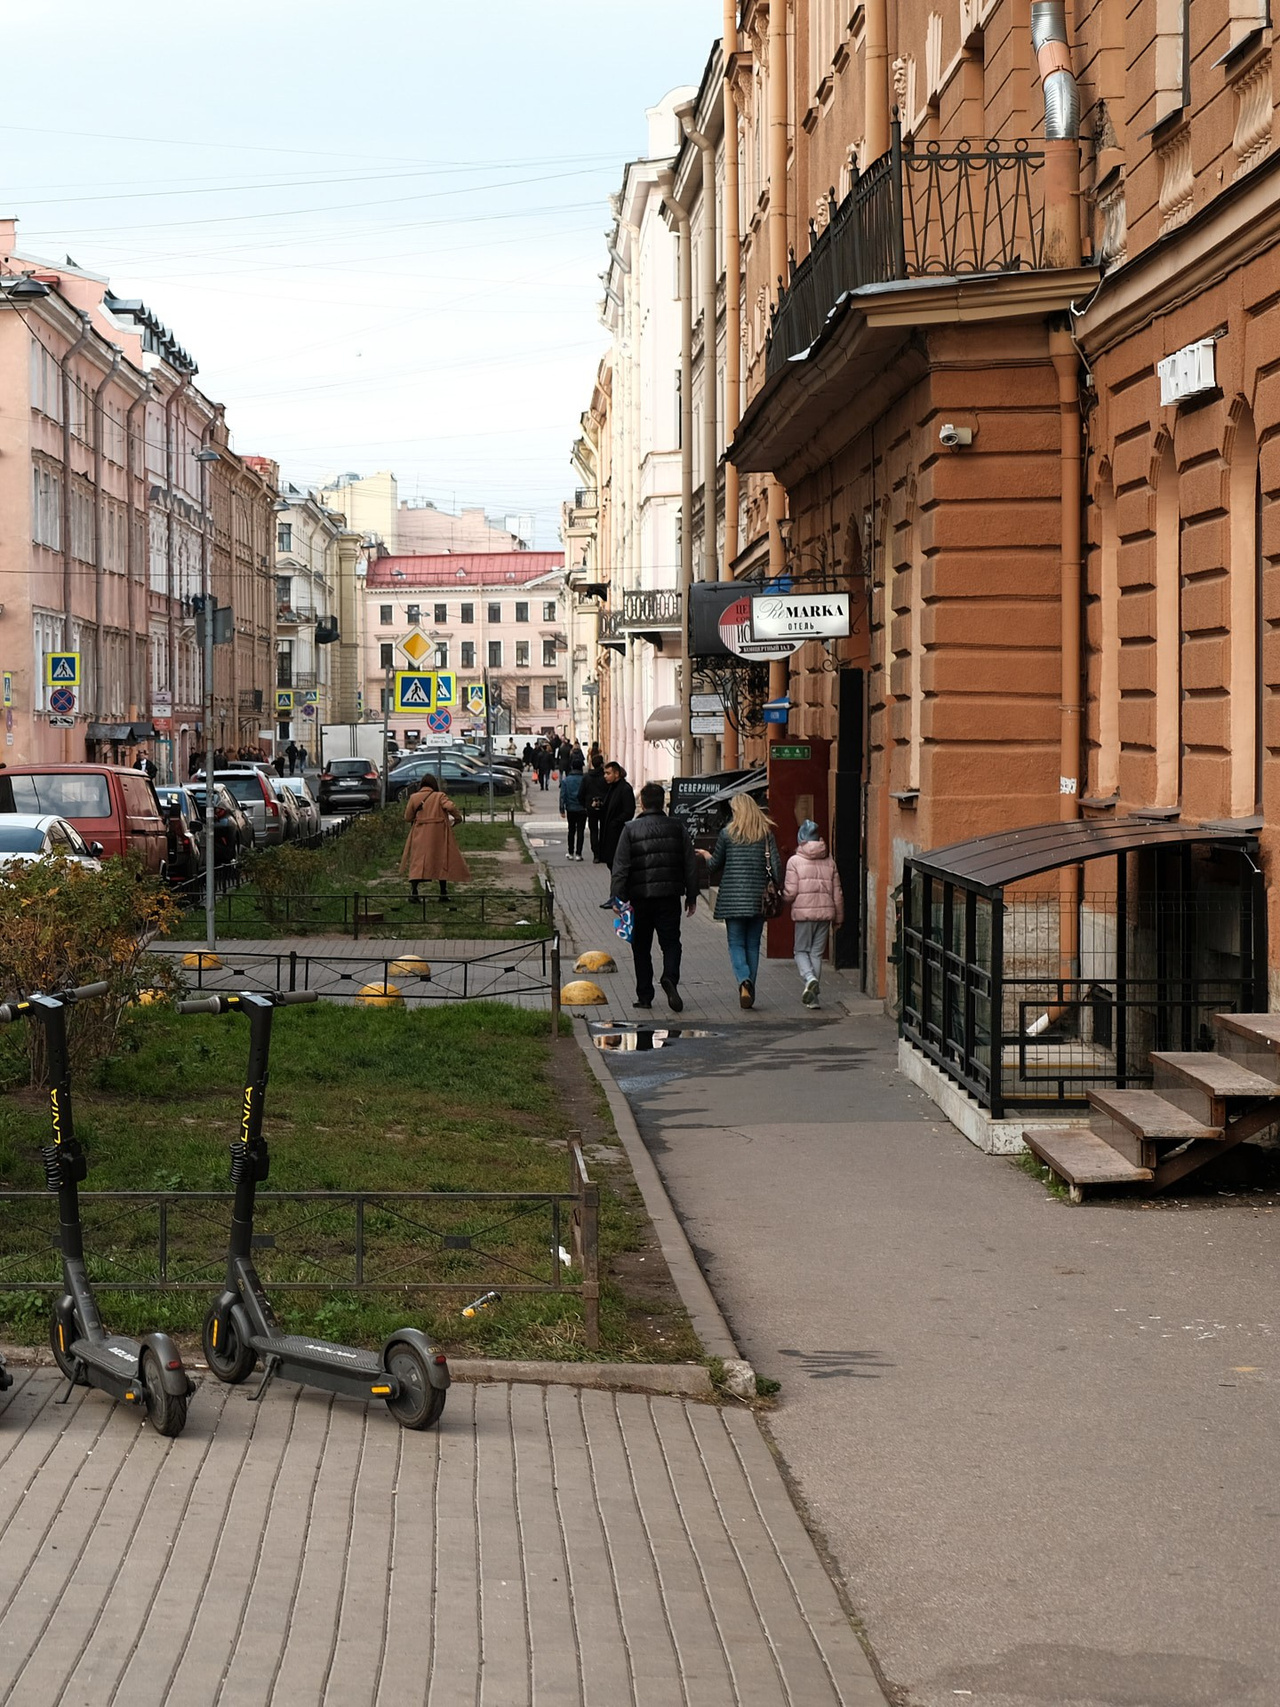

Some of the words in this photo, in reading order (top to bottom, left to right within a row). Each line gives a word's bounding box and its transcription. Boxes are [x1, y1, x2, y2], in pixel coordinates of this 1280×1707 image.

[736, 605, 748, 615] ЦЕ
[737, 624, 750, 643] ИС
[788, 622, 814, 631] ОТЕЛЬ
[678, 783, 721, 793] СЕВЕРЯНИН
[50, 1088, 61, 1144] LNIA
[240, 1086, 253, 1143] LNIA
